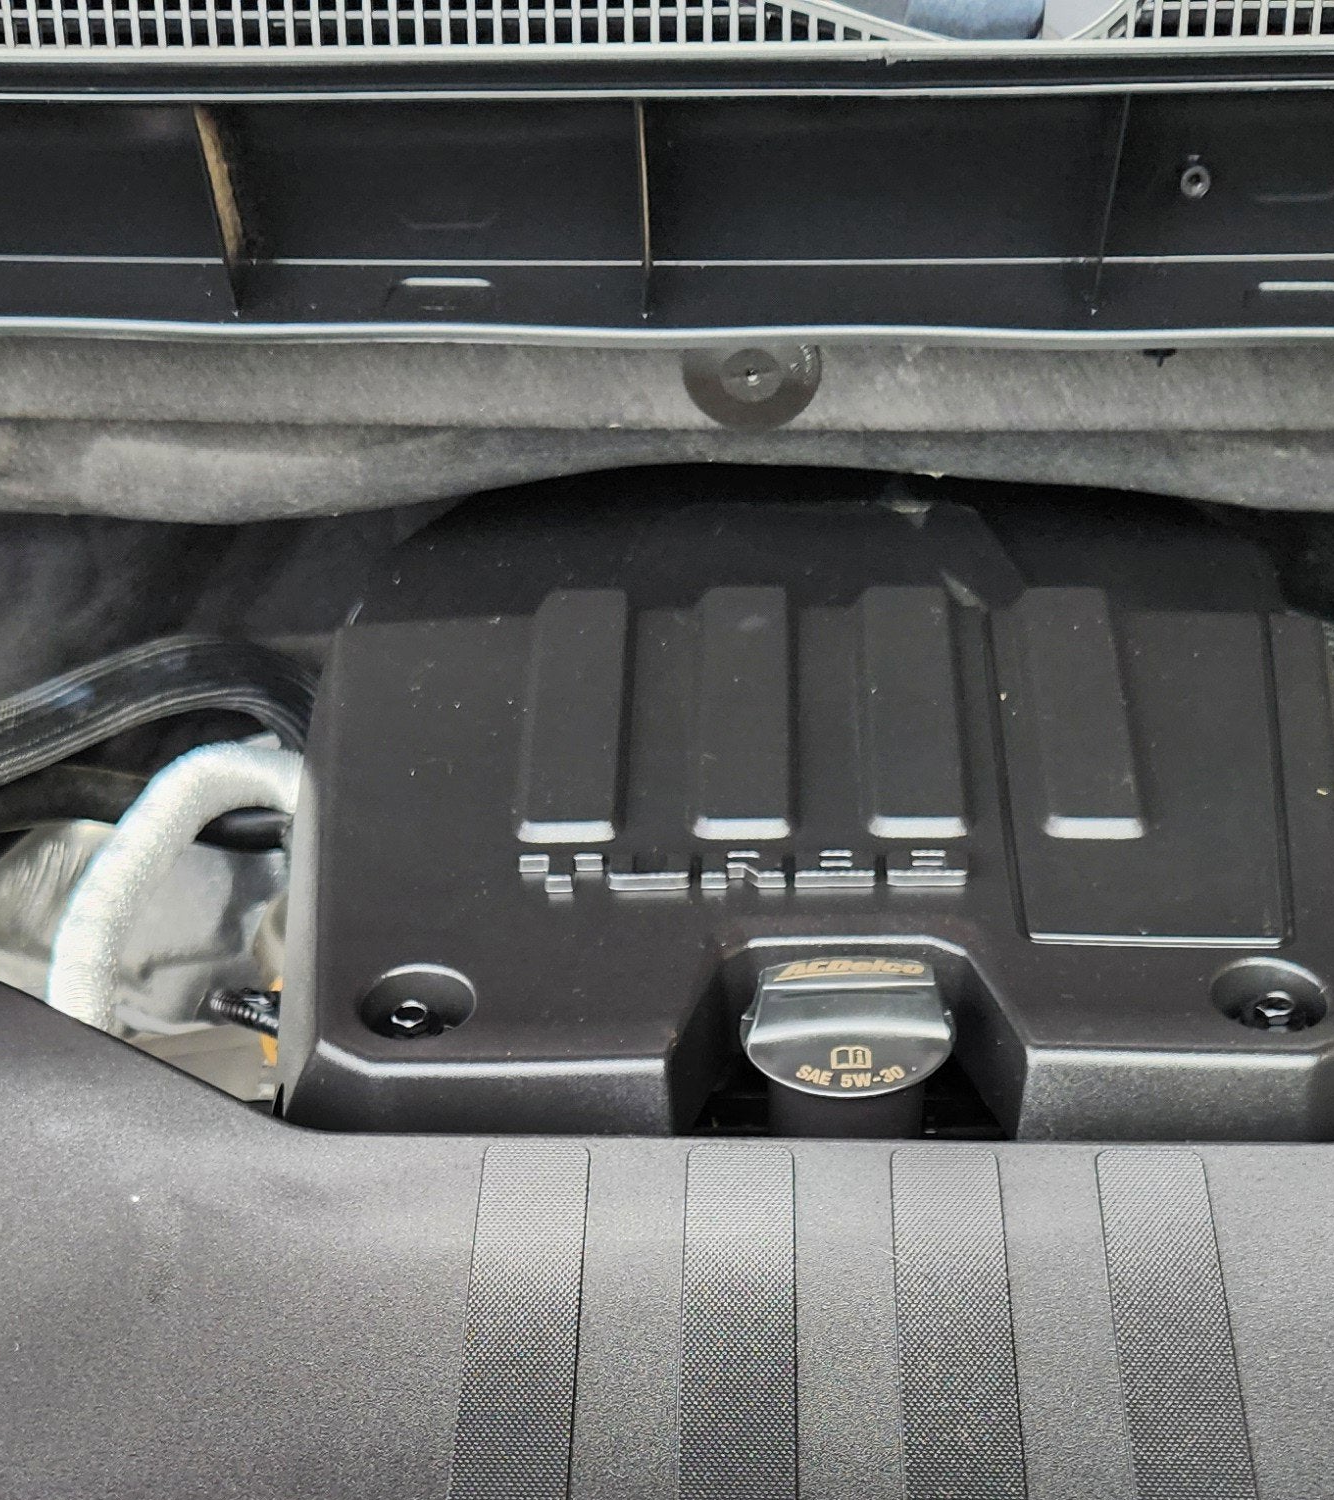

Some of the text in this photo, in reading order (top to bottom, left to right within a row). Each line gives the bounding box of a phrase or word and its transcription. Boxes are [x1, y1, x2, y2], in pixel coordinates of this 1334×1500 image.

[773, 959, 925, 982] ACDelco
[795, 1063, 906, 1088] SAE 5W-30
